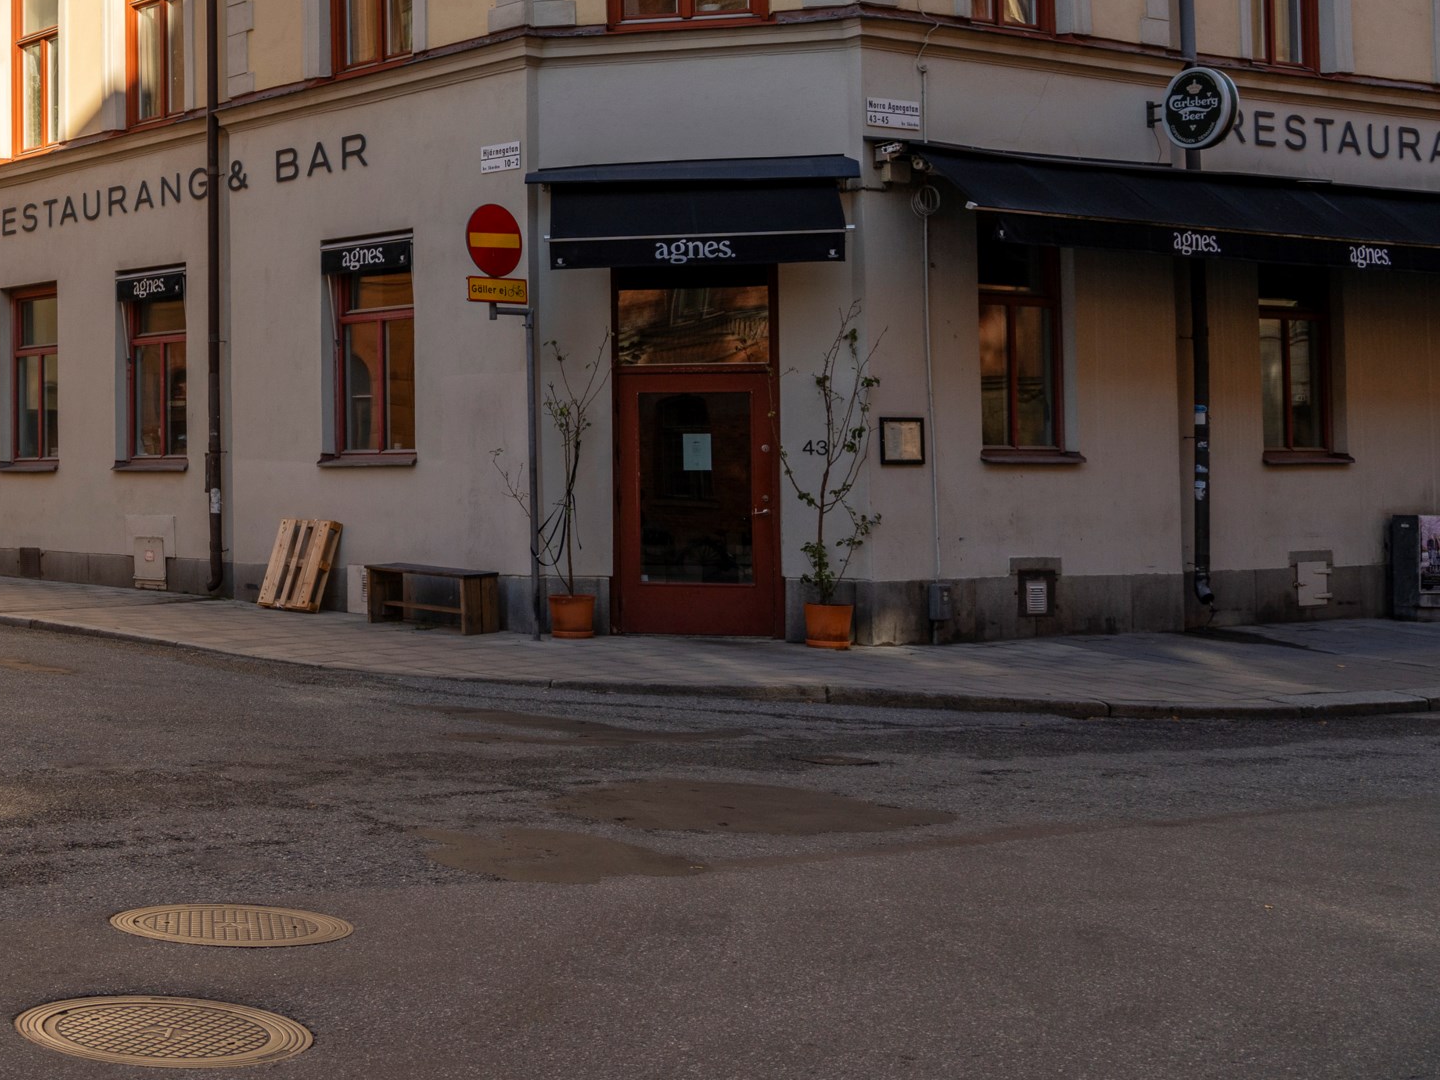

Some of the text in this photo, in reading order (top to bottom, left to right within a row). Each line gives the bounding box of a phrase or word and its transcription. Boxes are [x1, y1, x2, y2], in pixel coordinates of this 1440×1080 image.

[868, 100, 919, 114] Norra Agnegatan
[1169, 94, 1218, 112] Carlsberg
[868, 114, 889, 125] 43-45
[1182, 112, 1207, 121] Beer
[227, 159, 248, 192] &
[275, 132, 369, 184] BAR
[504, 158, 519, 168] 10-2
[654, 238, 736, 264] agnes.
[1173, 230, 1222, 256] agnes.
[342, 247, 385, 270] agnes.
[1348, 244, 1392, 268] agnes.
[471, 284, 507, 296] Gäller ej
[802, 439, 828, 456] 43
